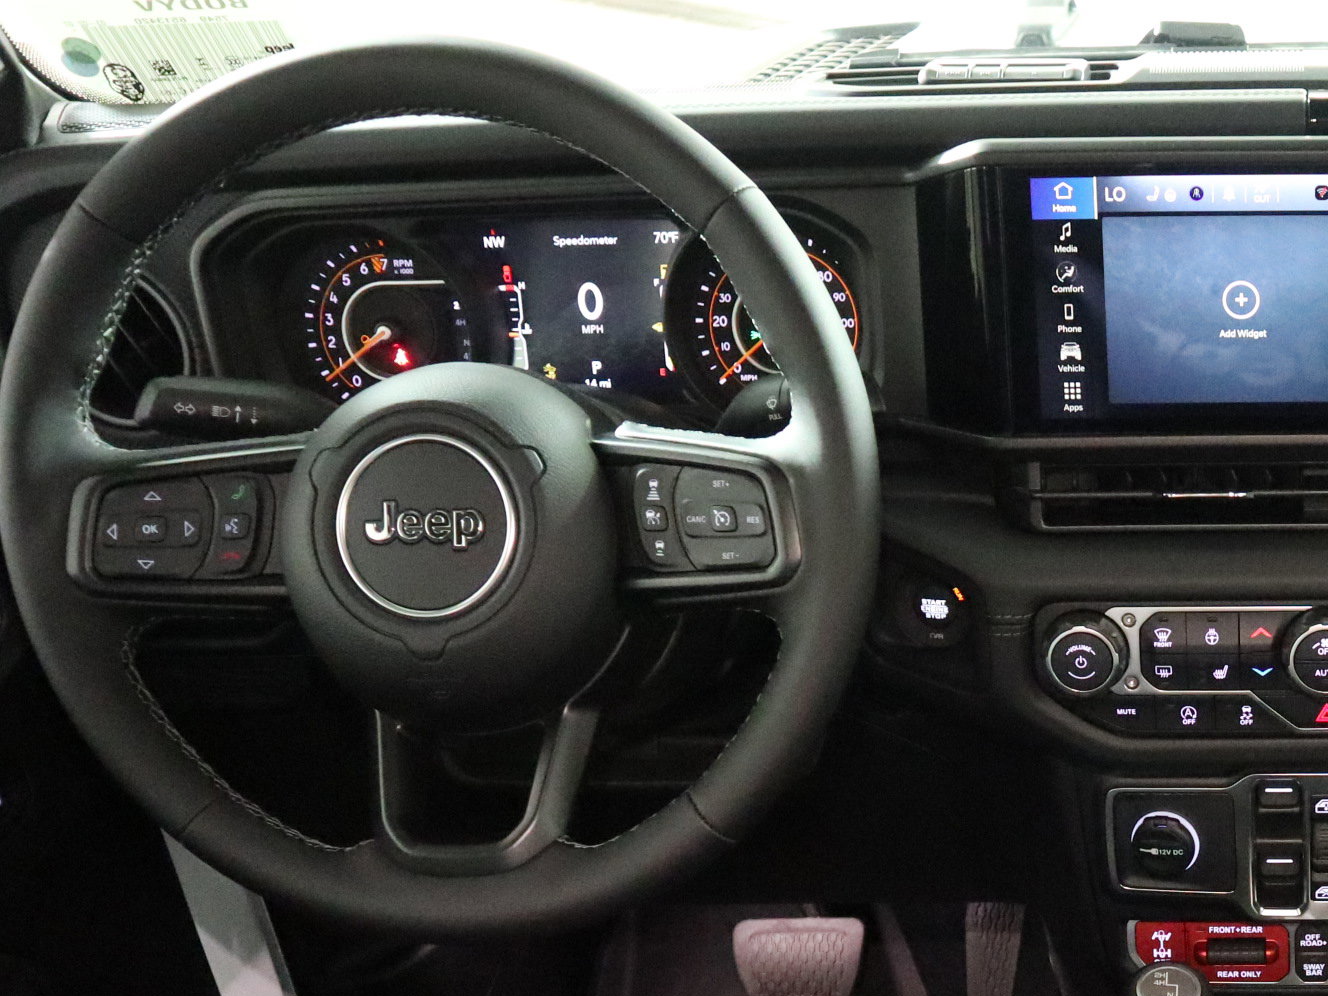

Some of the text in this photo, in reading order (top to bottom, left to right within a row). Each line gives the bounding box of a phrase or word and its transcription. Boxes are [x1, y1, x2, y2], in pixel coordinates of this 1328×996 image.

[1104, 186, 1126, 202] LO
[1052, 204, 1077, 213] Home
[483, 236, 506, 248] NW
[552, 235, 618, 247] Speedometer
[1054, 245, 1078, 253] Media
[379, 258, 388, 271] 7
[393, 259, 413, 268] RPM
[360, 263, 369, 275] 6
[342, 274, 351, 286] 5
[1052, 285, 1084, 293] Comfort
[329, 291, 338, 304] 4
[577, 281, 604, 321] 0
[719, 293, 732, 303] 30
[832, 293, 846, 302] 90
[325, 313, 334, 326] 3
[713, 316, 728, 327] 20
[581, 325, 604, 334] MPH
[1057, 325, 1082, 333] Phone
[1219, 329, 1268, 339] Add Widget
[328, 336, 336, 348] 2
[720, 342, 731, 351] 10
[591, 361, 602, 375] P
[1057, 364, 1085, 373] Vehicle
[352, 375, 362, 387] 0
[1063, 404, 1084, 412] Apps
[686, 515, 706, 523] CANC
[746, 515, 760, 524] RES
[141, 524, 159, 534] OK
[364, 500, 485, 549] Jeep
[1239, 718, 1253, 726] OFF
[1208, 926, 1263, 934] FRONT+REAR
